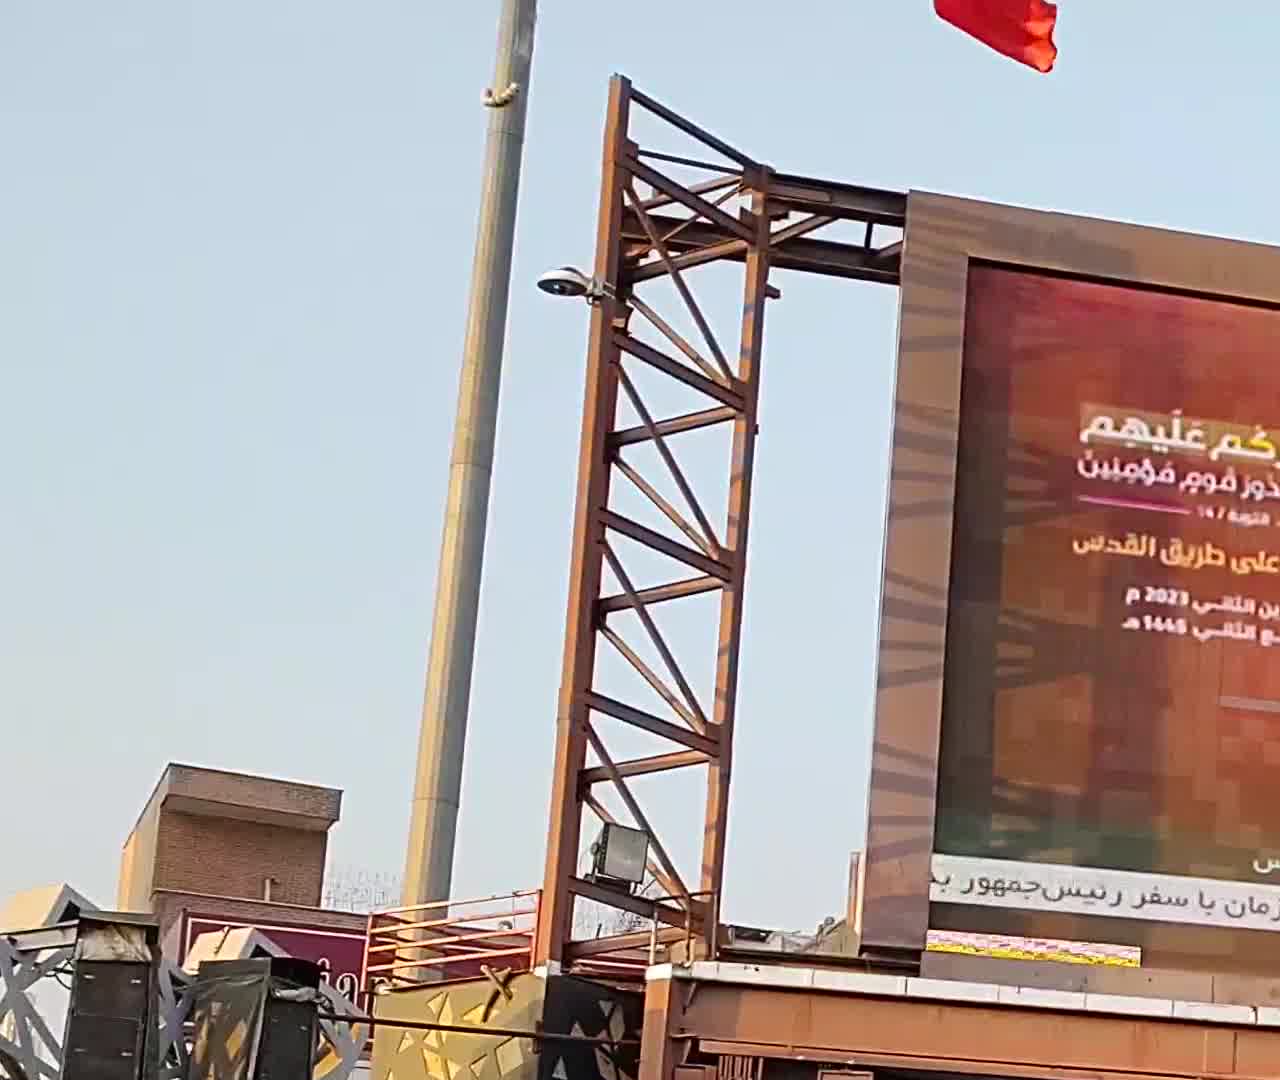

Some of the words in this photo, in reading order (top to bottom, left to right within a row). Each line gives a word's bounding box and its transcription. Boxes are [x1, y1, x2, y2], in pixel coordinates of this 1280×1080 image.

[1072, 530, 1156, 558] القدس
[1160, 537, 1226, 570] طريق
[1131, 885, 1188, 910] سفر
[1199, 889, 1216, 916] با
